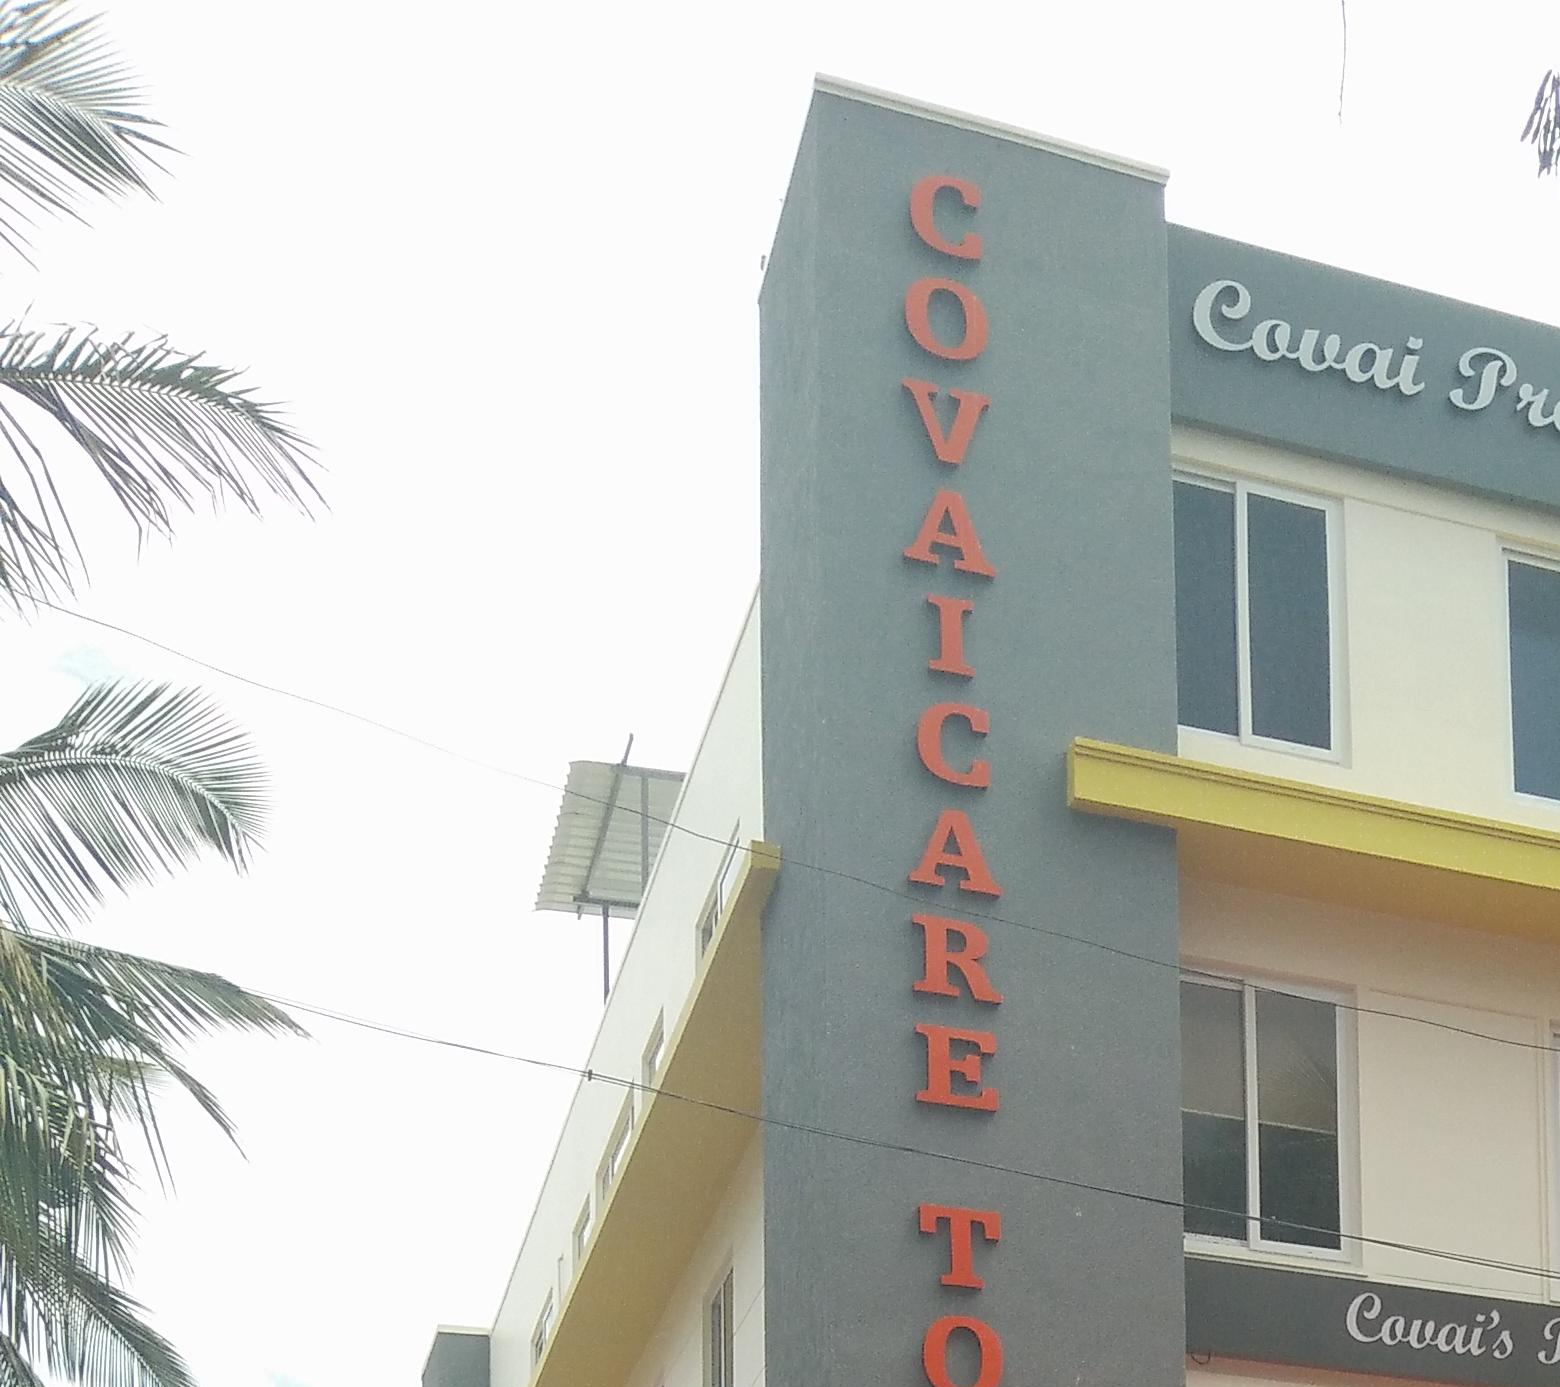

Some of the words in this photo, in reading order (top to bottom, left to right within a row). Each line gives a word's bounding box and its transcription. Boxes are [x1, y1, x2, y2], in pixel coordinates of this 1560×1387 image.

[1191, 278, 1427, 398] Covai
[902, 174, 1004, 1114] COVAICARE
[1345, 1291, 1514, 1360] Covai's
